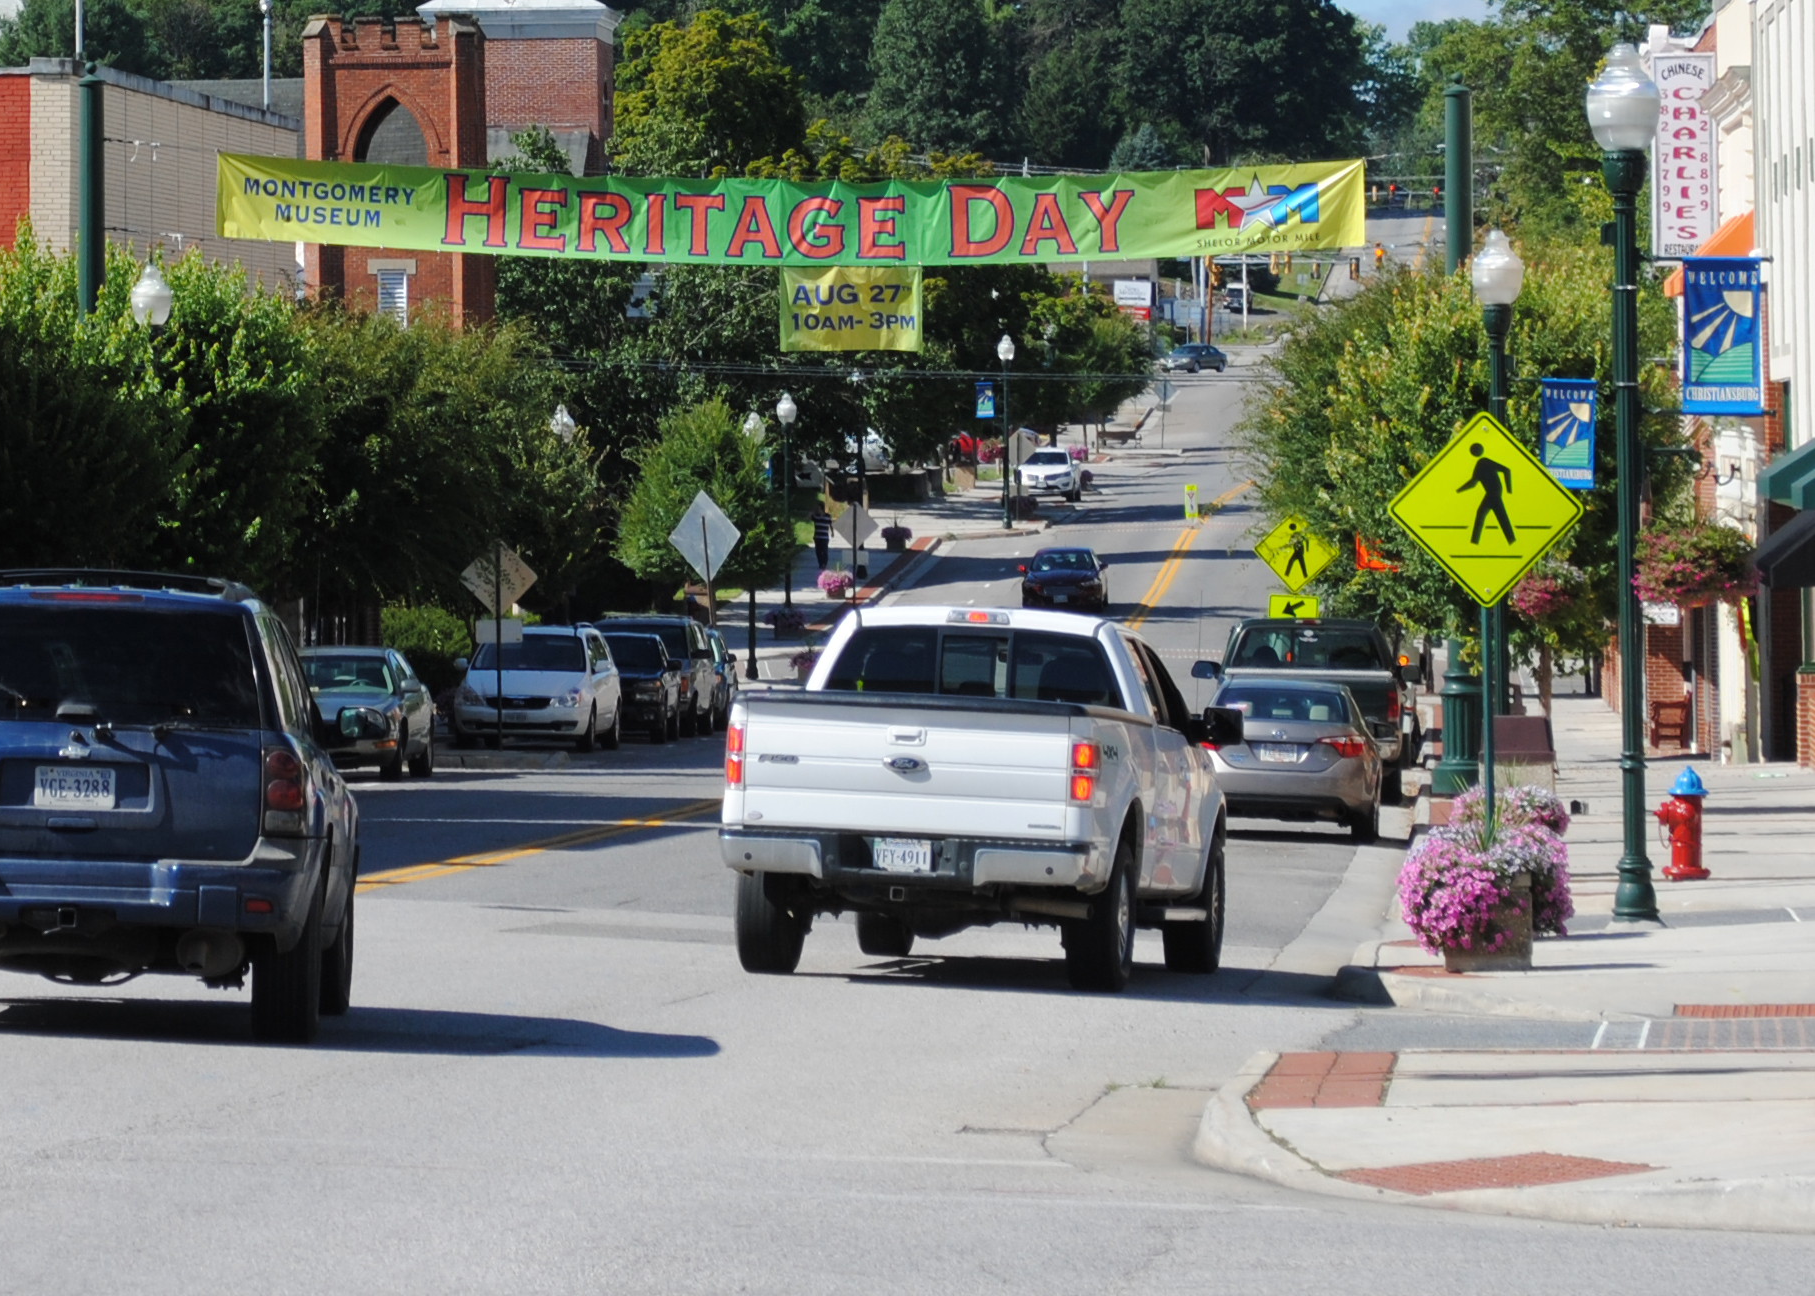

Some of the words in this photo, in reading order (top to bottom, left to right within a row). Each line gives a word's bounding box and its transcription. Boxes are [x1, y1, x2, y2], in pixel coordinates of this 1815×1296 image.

[1661, 62, 1706, 81] CHINESE
[1667, 86, 1699, 240] CHARLIE'S
[242, 176, 416, 206] MONTGOMERY
[274, 203, 382, 228] MUSEUM
[440, 172, 906, 261] HERITAGE
[946, 183, 1135, 258] DAY
[1196, 237, 1241, 249] SHELOR
[1246, 234, 1289, 246] MOTOR
[1294, 231, 1322, 243] MILE
[1687, 270, 1758, 286] WELCOME
[791, 283, 859, 306] AUG
[868, 311, 916, 331] 3PM
[1545, 388, 1594, 401] WELCOME
[1686, 386, 1760, 402] CHRISTIANSBURG
[56, 770, 94, 778] VIRGINIA
[39, 778, 111, 799] VGE-3288
